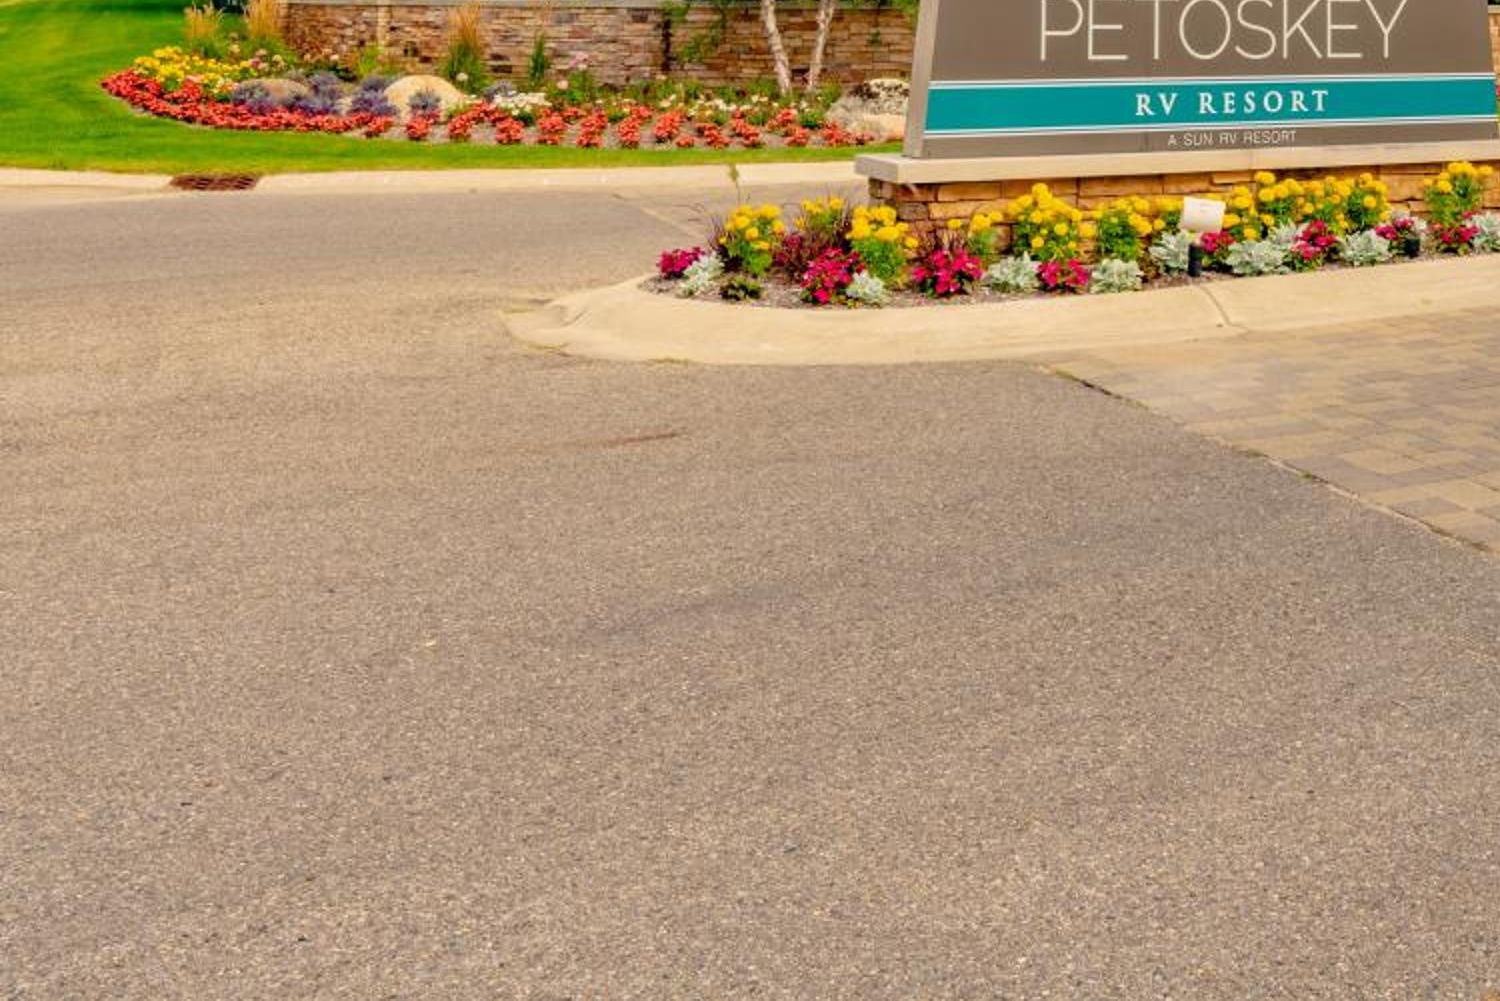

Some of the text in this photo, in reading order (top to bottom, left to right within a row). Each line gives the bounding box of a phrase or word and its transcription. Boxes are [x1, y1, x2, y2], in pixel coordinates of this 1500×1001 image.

[1135, 90, 1329, 116] RV RESORT
[1167, 130, 1297, 146] A SUN RV RESORT
